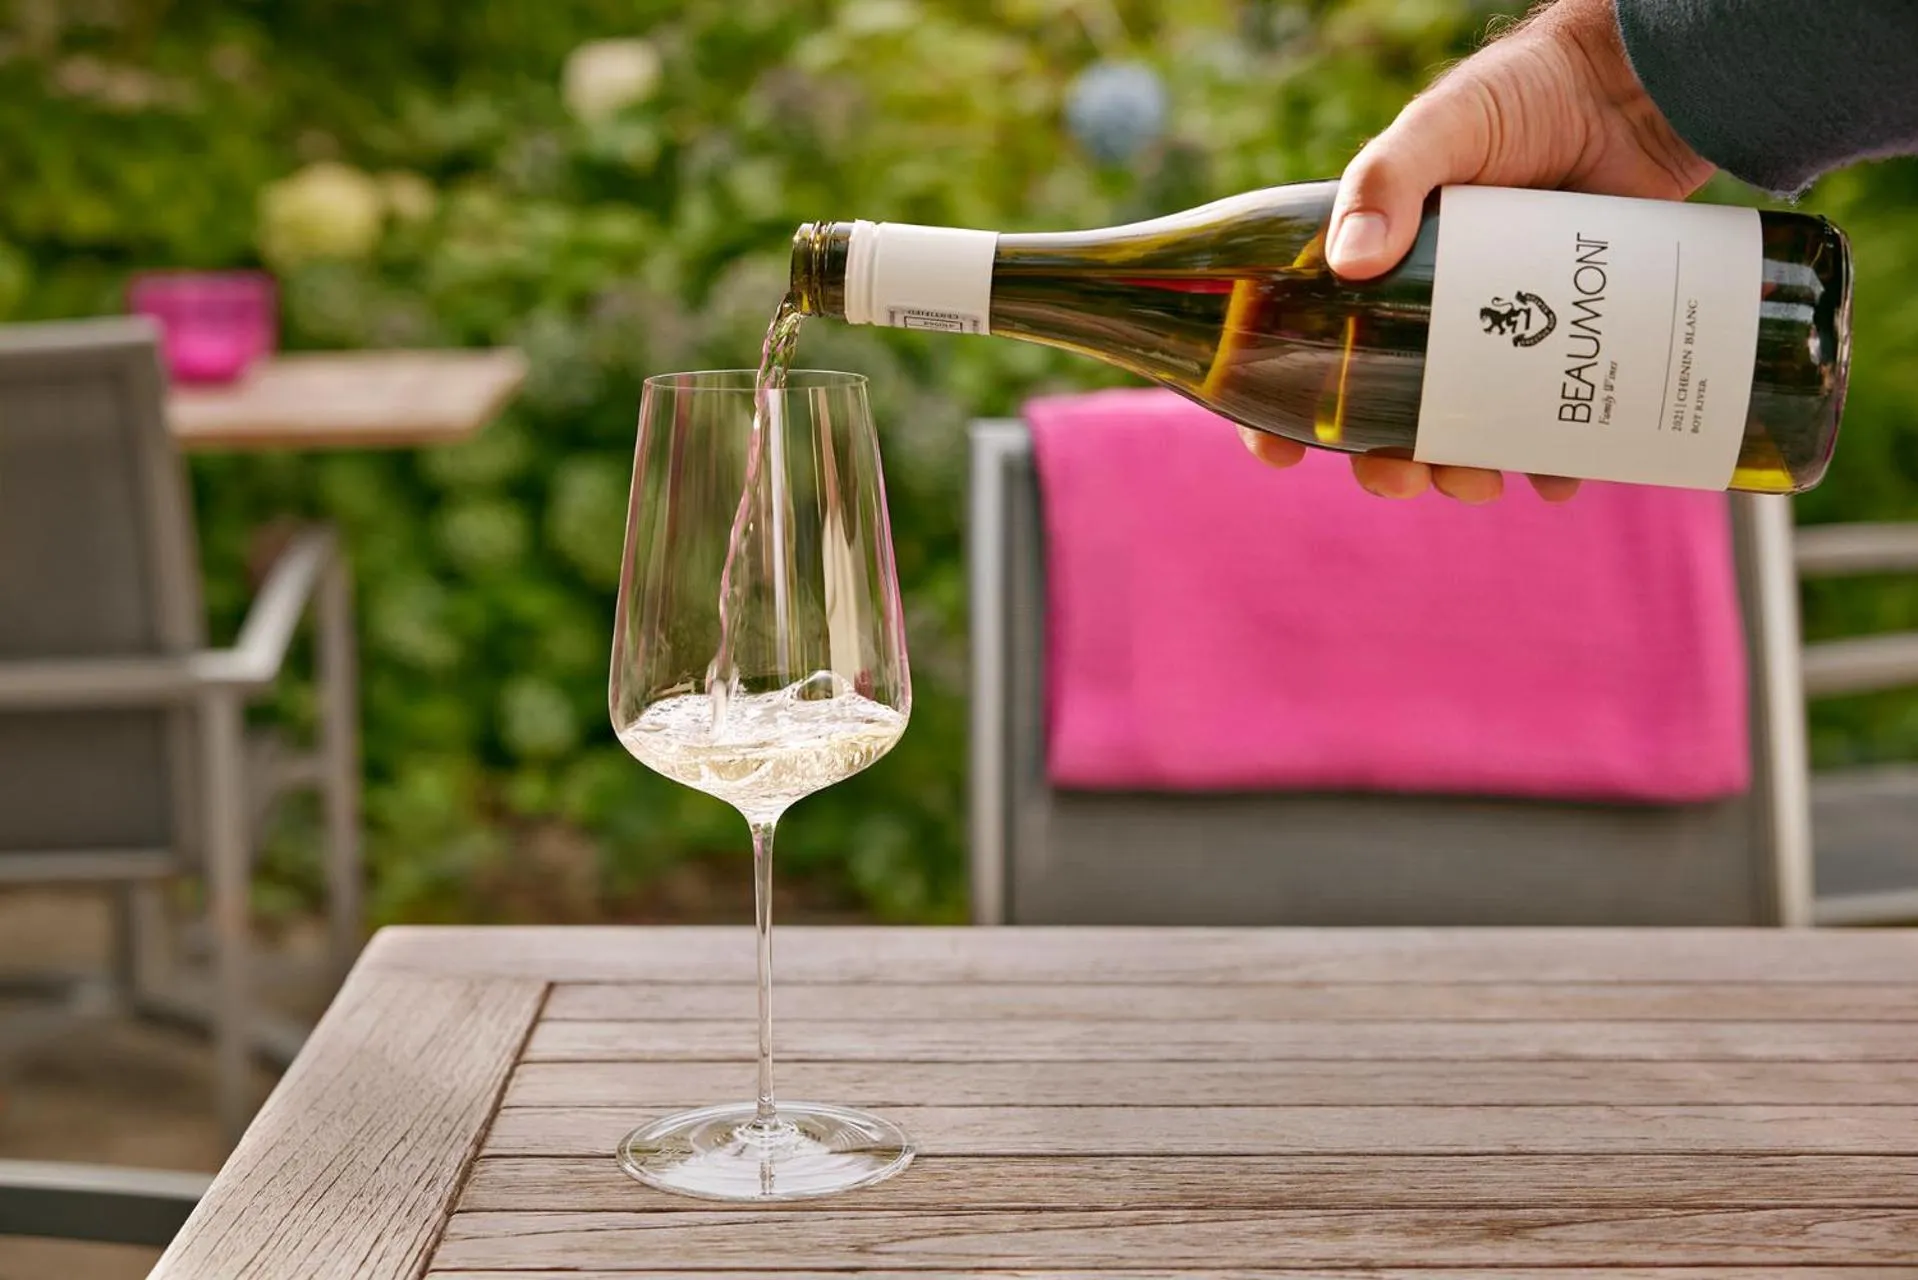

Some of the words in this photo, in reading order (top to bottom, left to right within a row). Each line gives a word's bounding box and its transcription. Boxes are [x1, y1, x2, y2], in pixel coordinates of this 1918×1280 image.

[1558, 232, 1608, 423] BEAUMONT
[1684, 299, 1698, 345] BLANC
[1603, 361, 1618, 391] Wines
[1677, 350, 1693, 402] CHENIN
[1598, 395, 1616, 425] Family
[1695, 378, 1708, 411] RIVER
[1671, 409, 1685, 431] 2021
[1691, 414, 1702, 433] BOT
